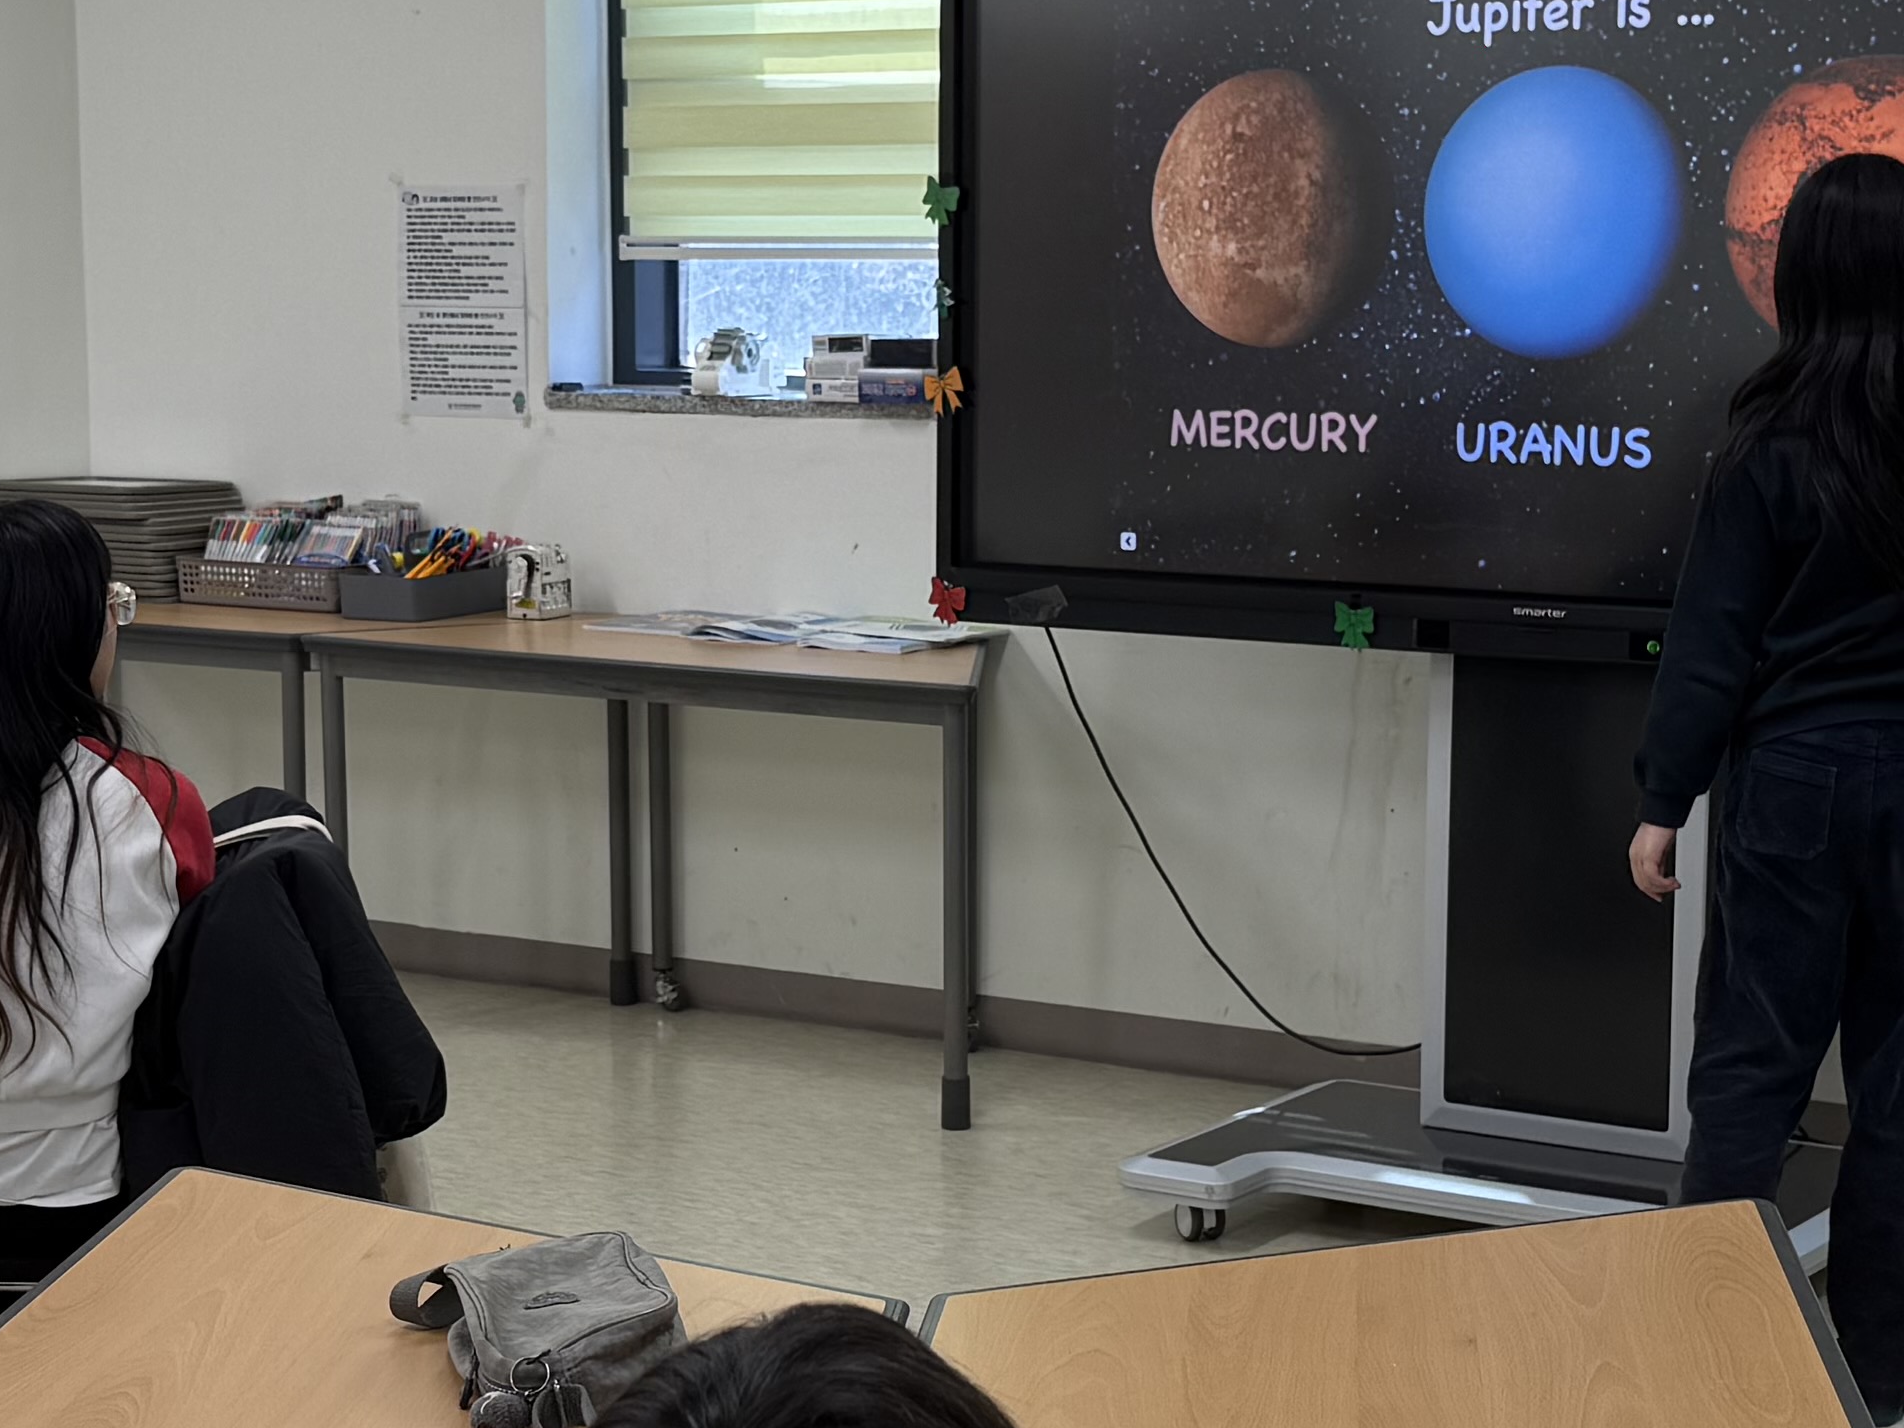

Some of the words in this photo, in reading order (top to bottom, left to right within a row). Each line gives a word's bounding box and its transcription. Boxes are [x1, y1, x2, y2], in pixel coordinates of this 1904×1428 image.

[1169, 408, 1379, 454] MERCURY
[1455, 420, 1652, 470] URANUS
[1512, 606, 1568, 619] smarter
